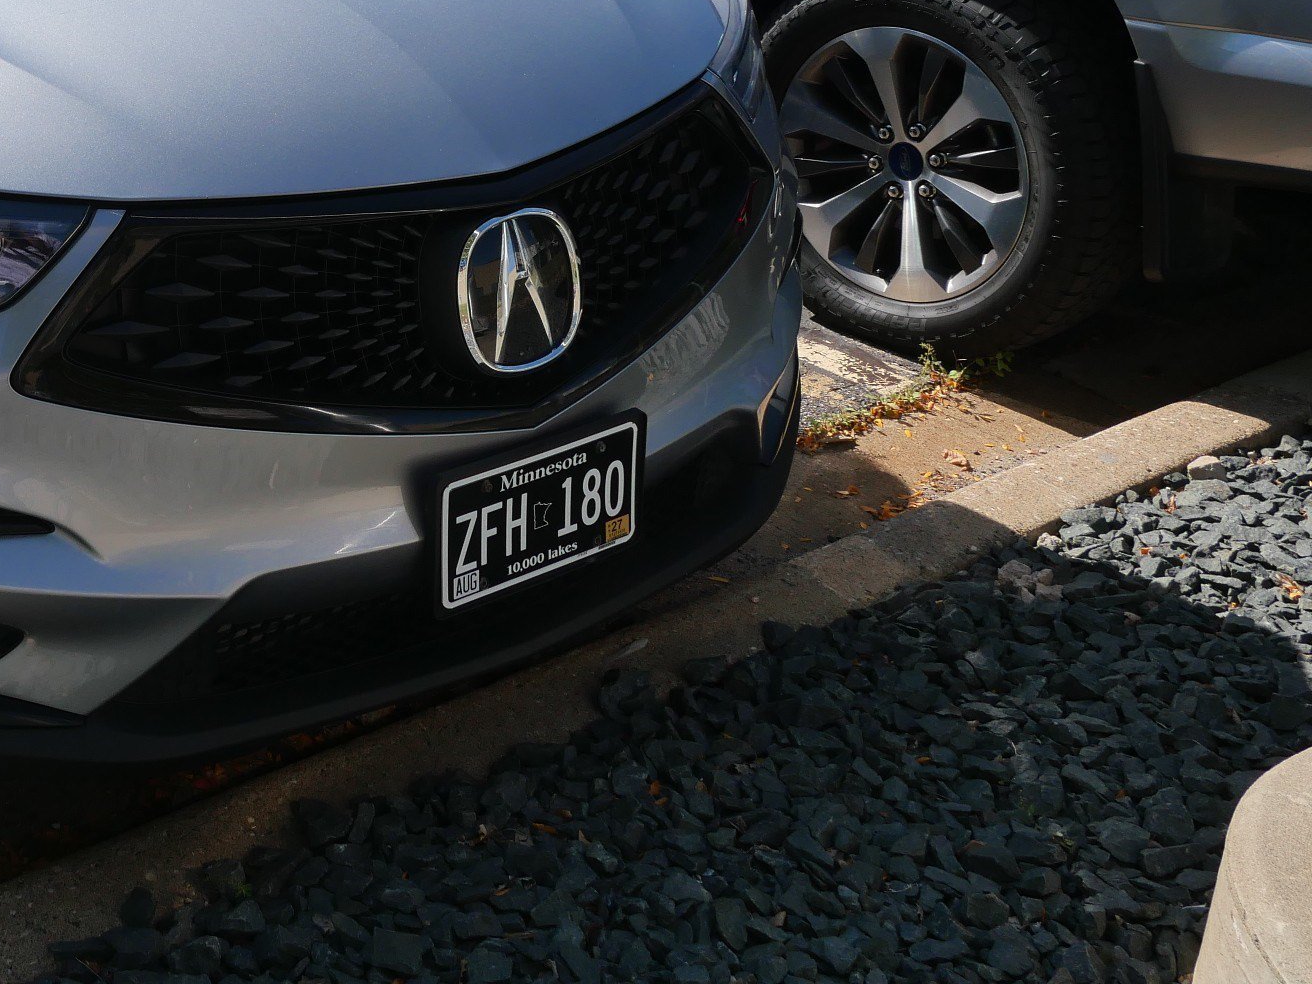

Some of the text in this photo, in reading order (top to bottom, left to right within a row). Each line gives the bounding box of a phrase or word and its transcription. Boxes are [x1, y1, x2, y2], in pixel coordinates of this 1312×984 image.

[500, 451, 587, 492] Minnesota
[455, 459, 625, 575] ZFH 180
[611, 519, 622, 532] 27
[507, 553, 545, 575] 10,000
[548, 541, 578, 560] lakes
[456, 573, 478, 596] AUG
